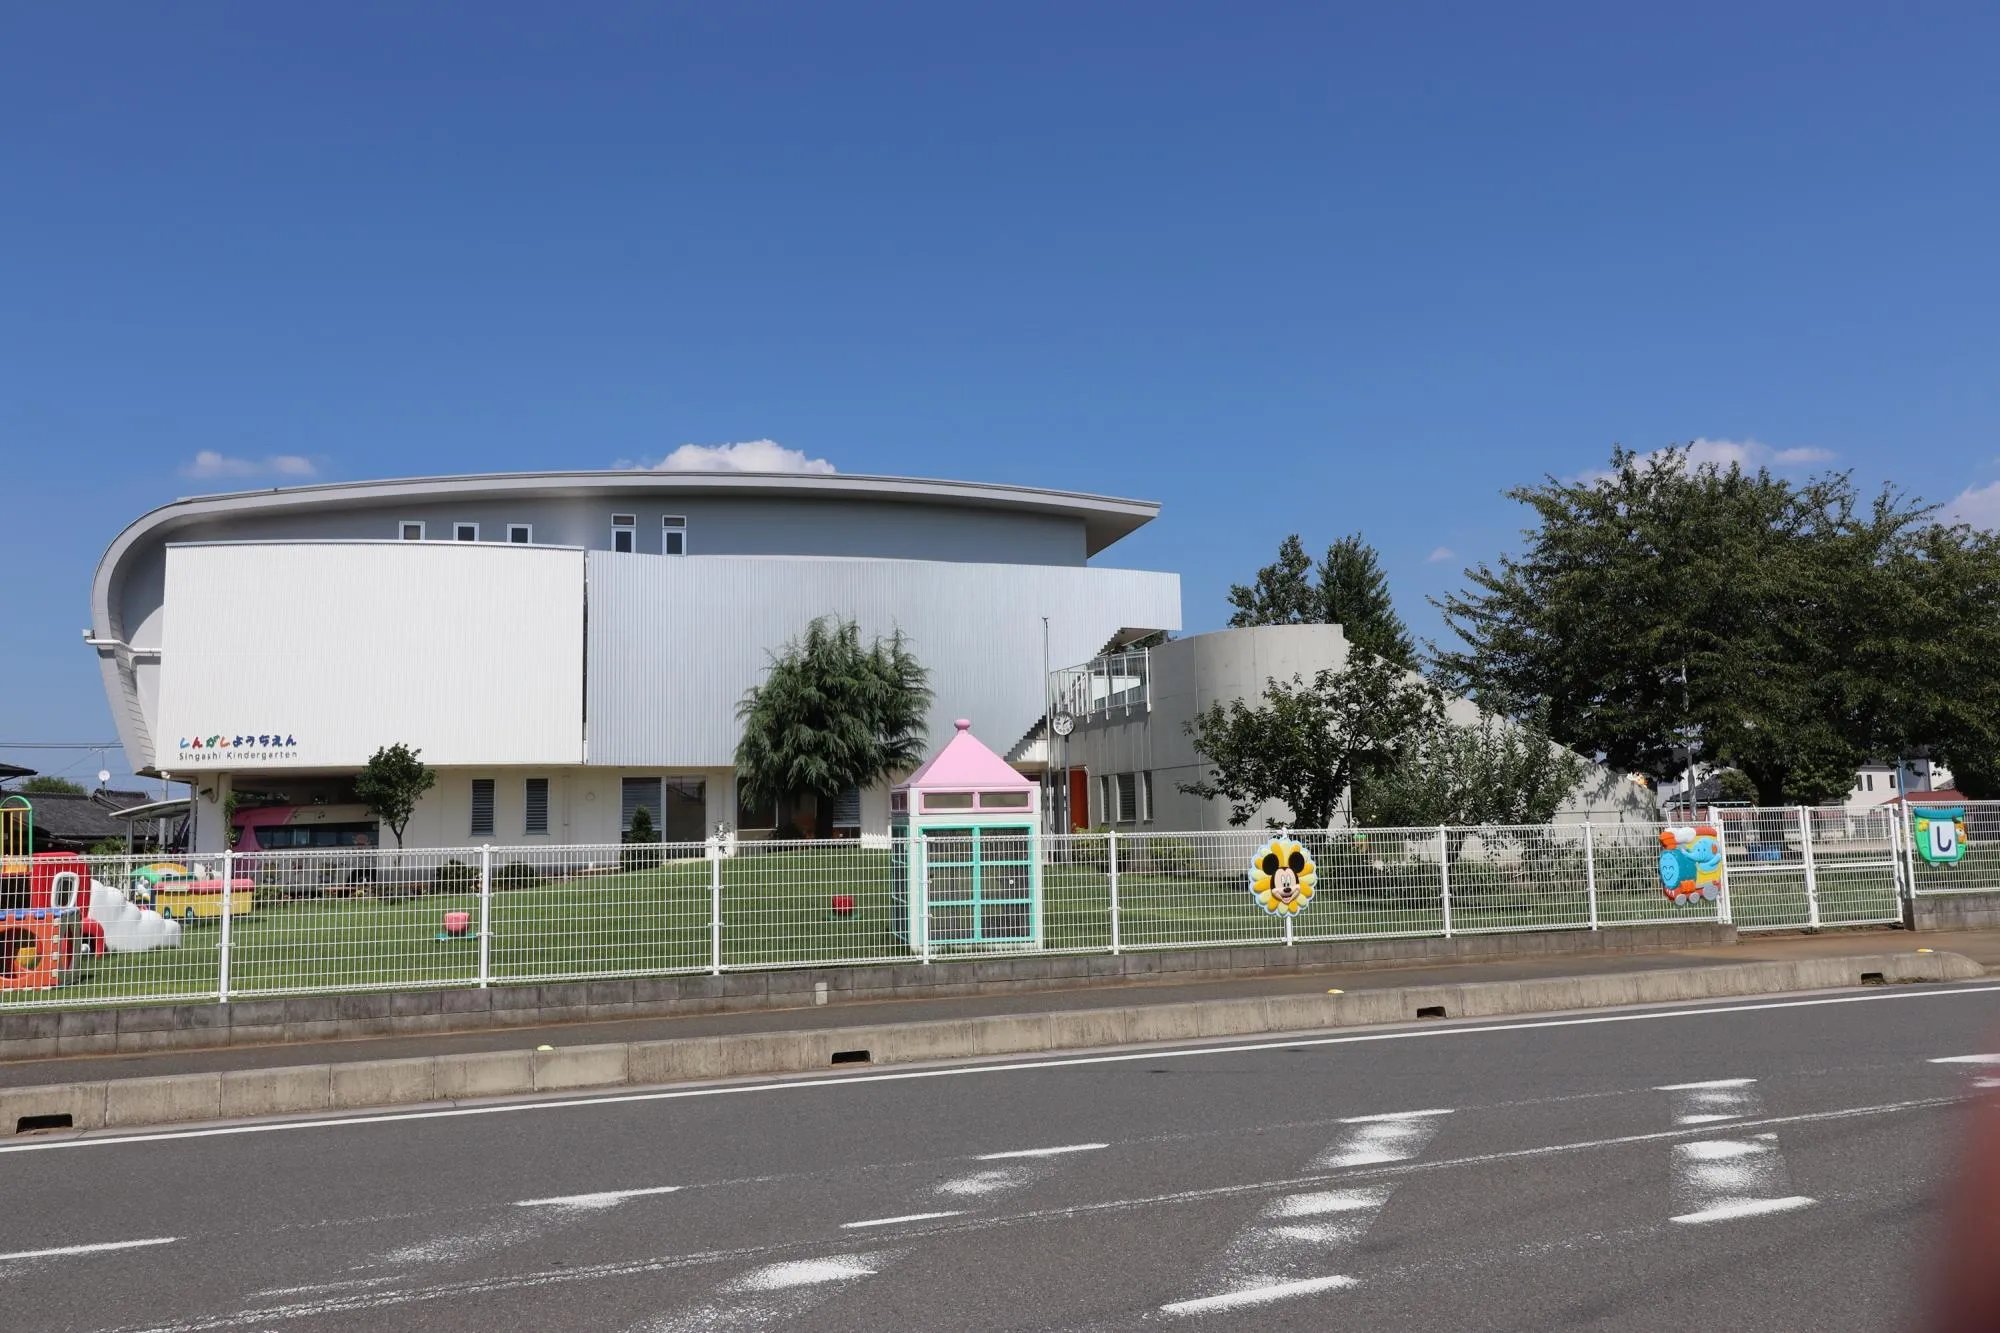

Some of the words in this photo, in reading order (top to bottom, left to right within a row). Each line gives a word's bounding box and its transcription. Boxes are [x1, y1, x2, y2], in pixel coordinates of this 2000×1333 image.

[179, 751, 221, 762] Singashi
[226, 751, 297, 760] Kindergarten
[1936, 825, 1952, 852] し
